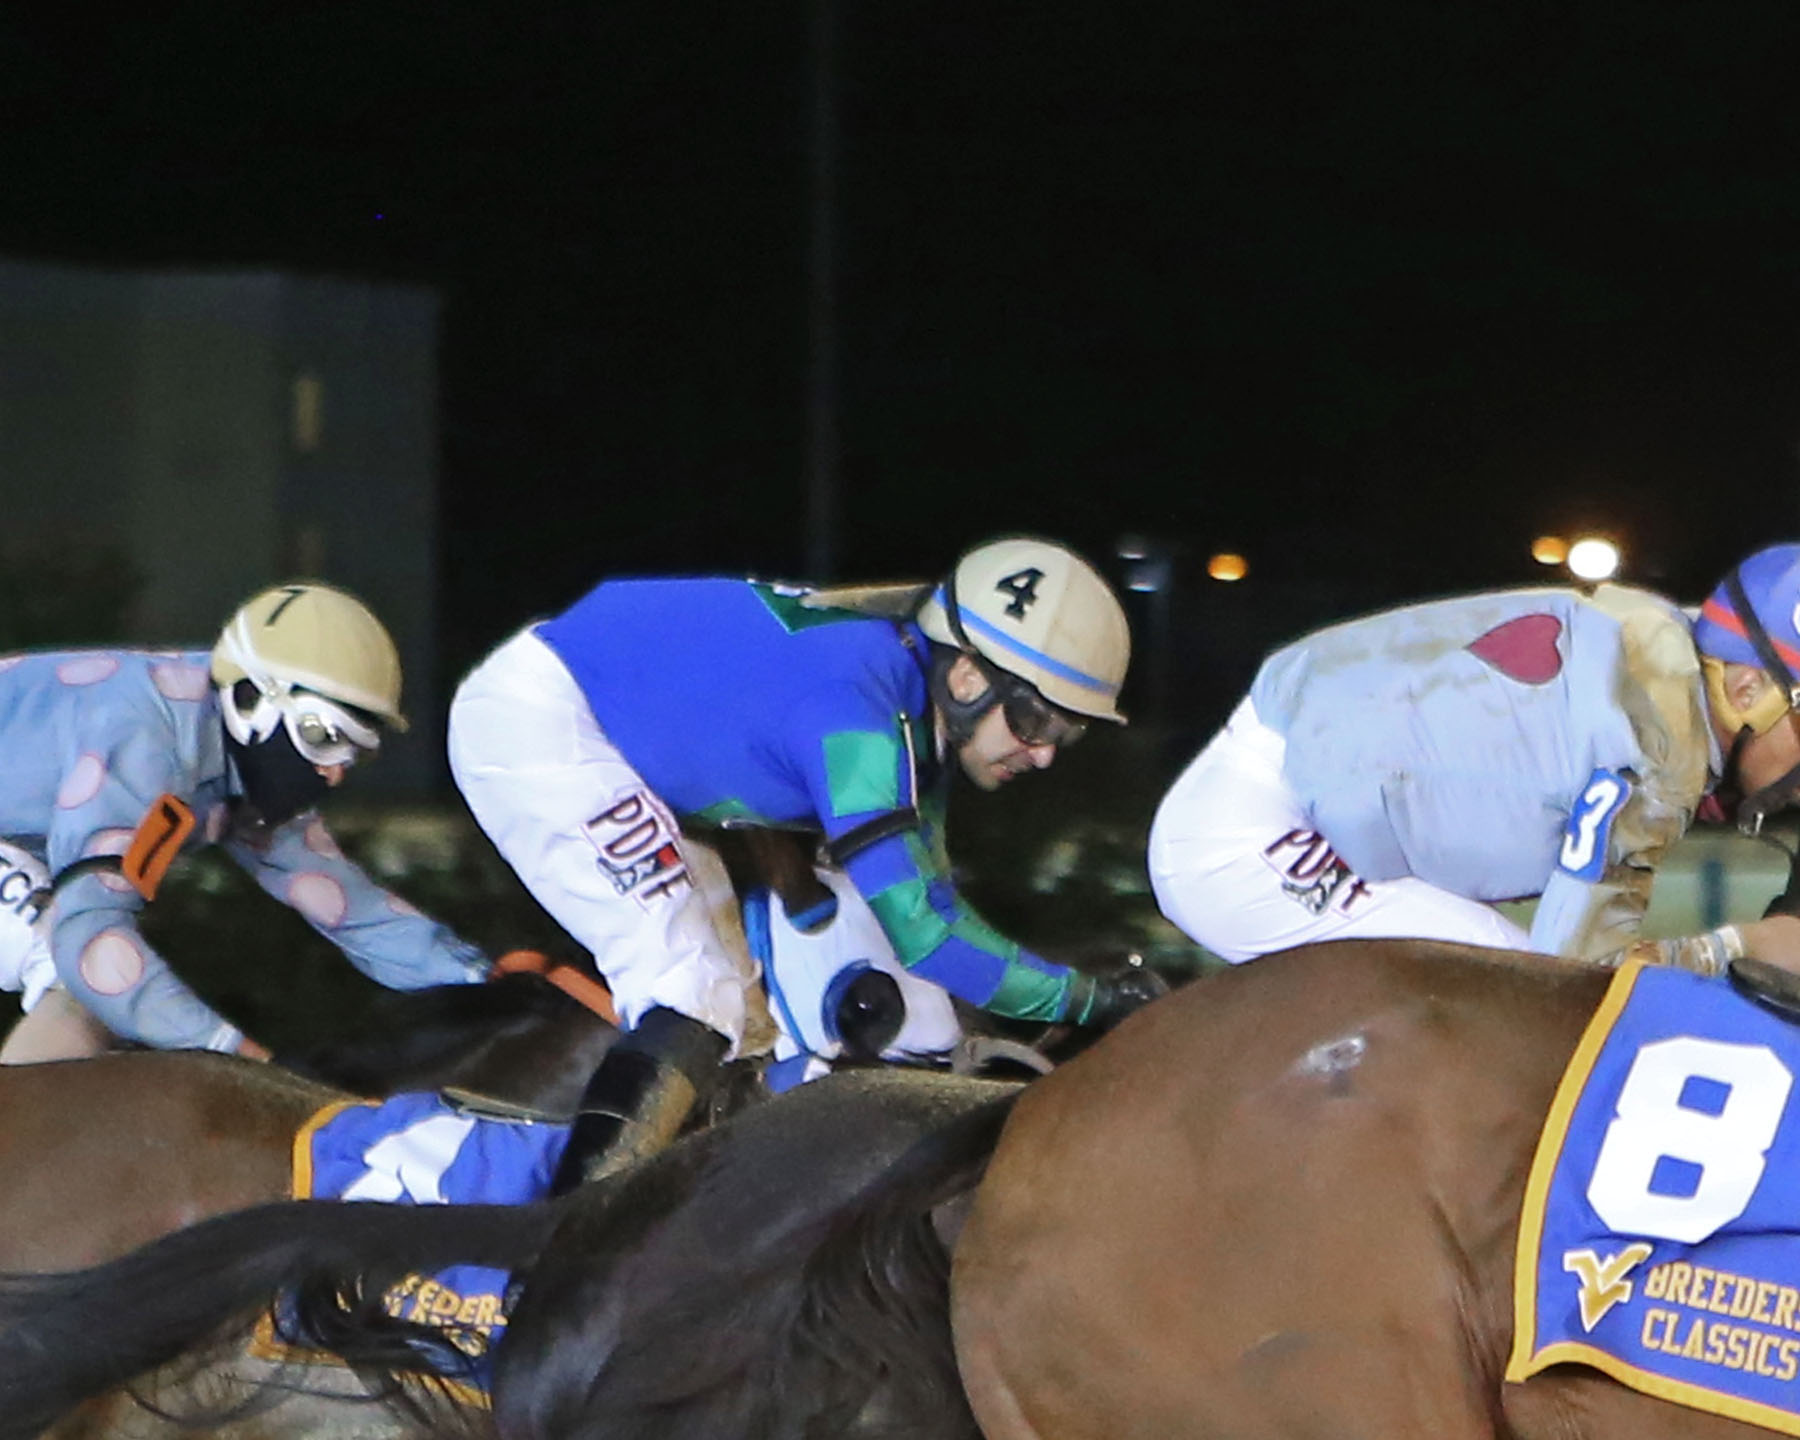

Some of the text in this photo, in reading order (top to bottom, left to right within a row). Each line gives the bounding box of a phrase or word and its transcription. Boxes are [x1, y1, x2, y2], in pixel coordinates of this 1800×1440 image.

[264, 588, 302, 626] 7
[994, 567, 1046, 622] 4
[138, 801, 182, 881] 7
[1565, 777, 1622, 872] 3
[1586, 1036, 1793, 1245] 8
